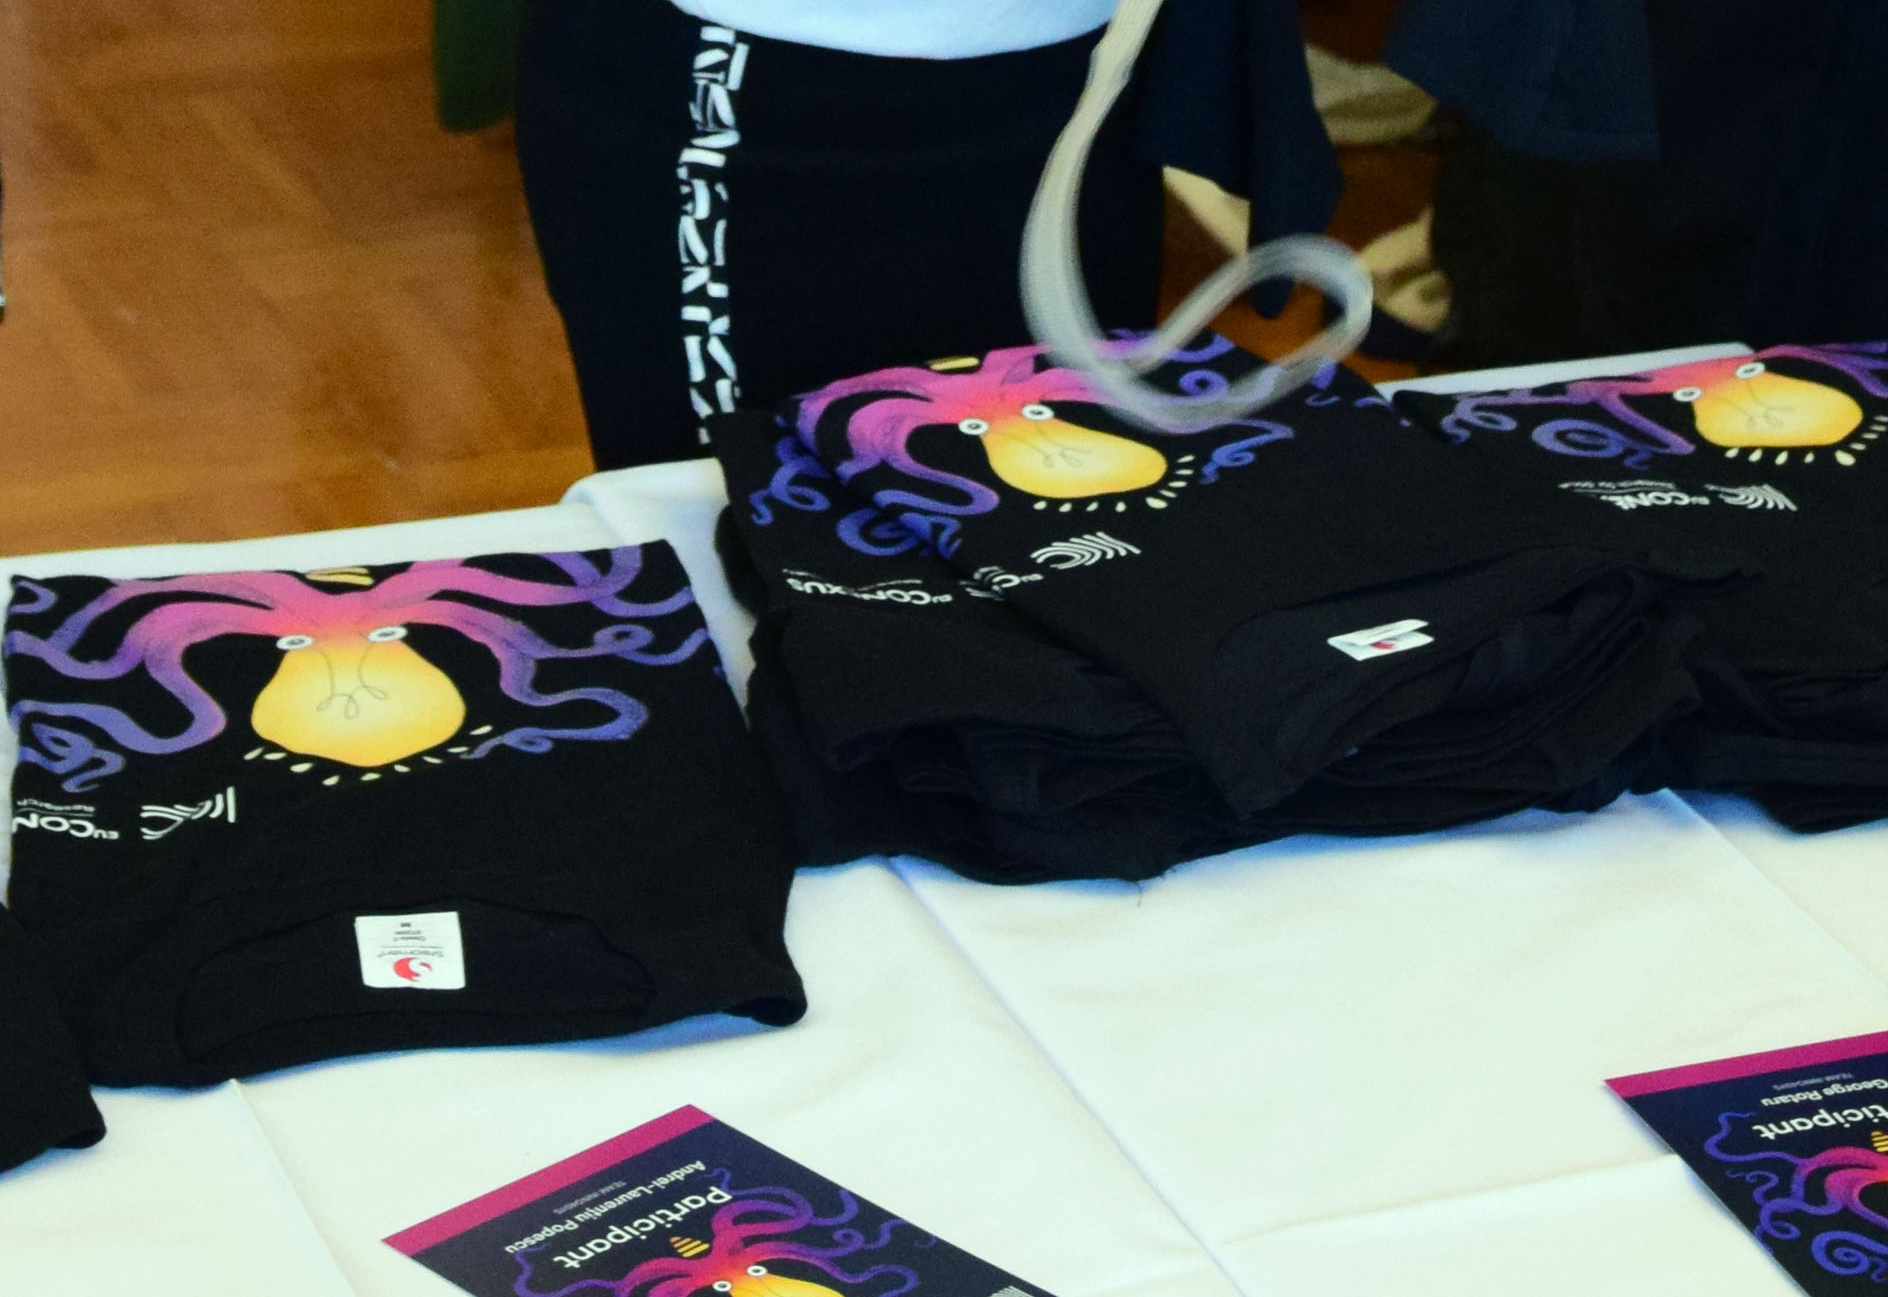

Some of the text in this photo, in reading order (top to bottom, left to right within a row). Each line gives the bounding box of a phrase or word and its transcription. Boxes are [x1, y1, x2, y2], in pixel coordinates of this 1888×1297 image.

[1760, 1090, 1823, 1108] Rotaru
[504, 1219, 579, 1255] Popescu
[552, 1186, 733, 1269] Participant
